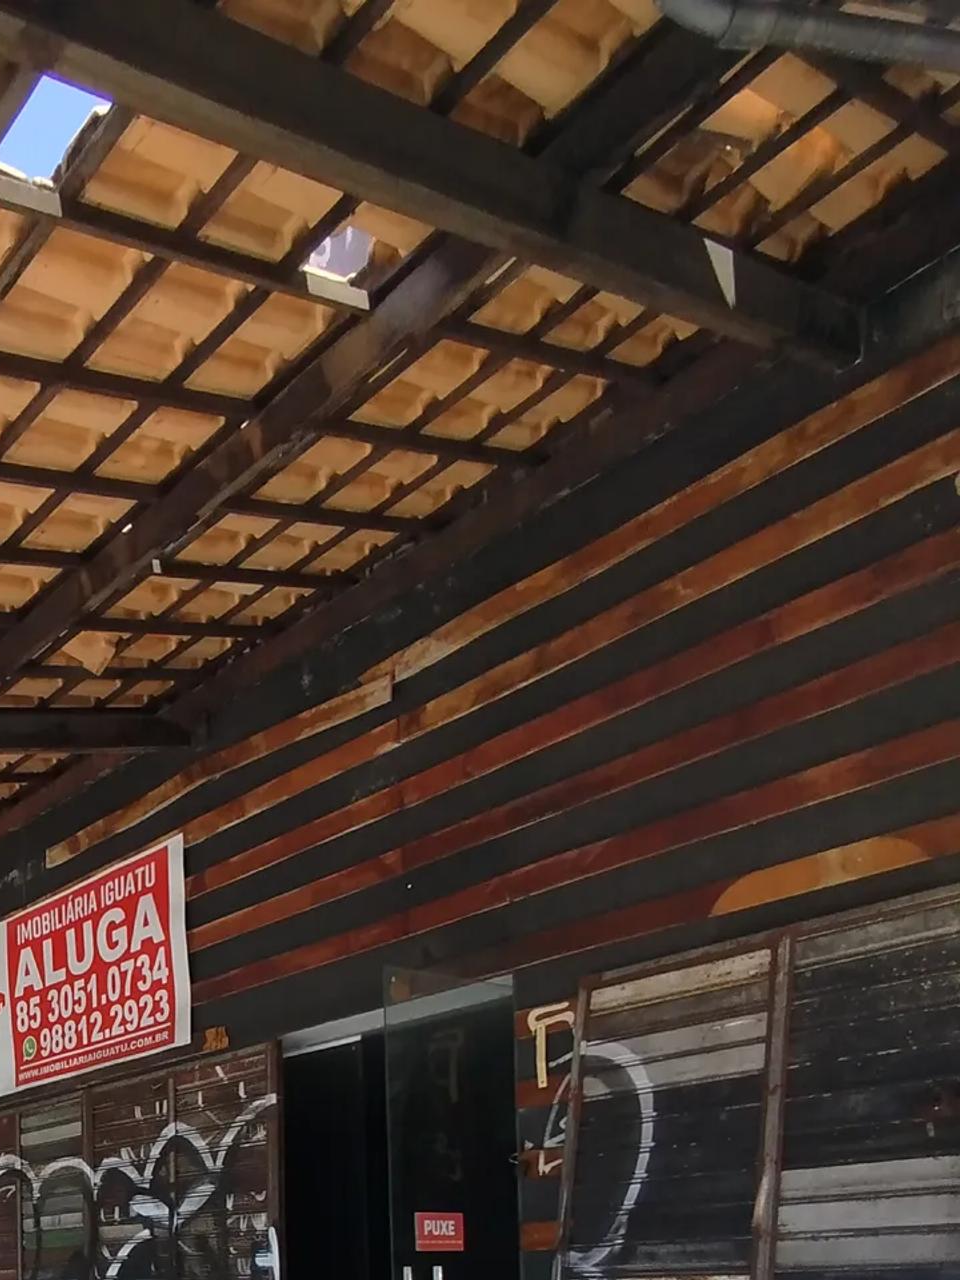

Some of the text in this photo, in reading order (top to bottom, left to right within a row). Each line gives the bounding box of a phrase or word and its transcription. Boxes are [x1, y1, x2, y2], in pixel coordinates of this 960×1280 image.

[14, 892, 165, 998] ALUGA
[17, 862, 156, 945] IMOBILIÁRIA IGUATU
[16, 946, 169, 1033] 85 3051.0734
[41, 989, 170, 1057] 98812.2923
[423, 1220, 456, 1236] PUXE
